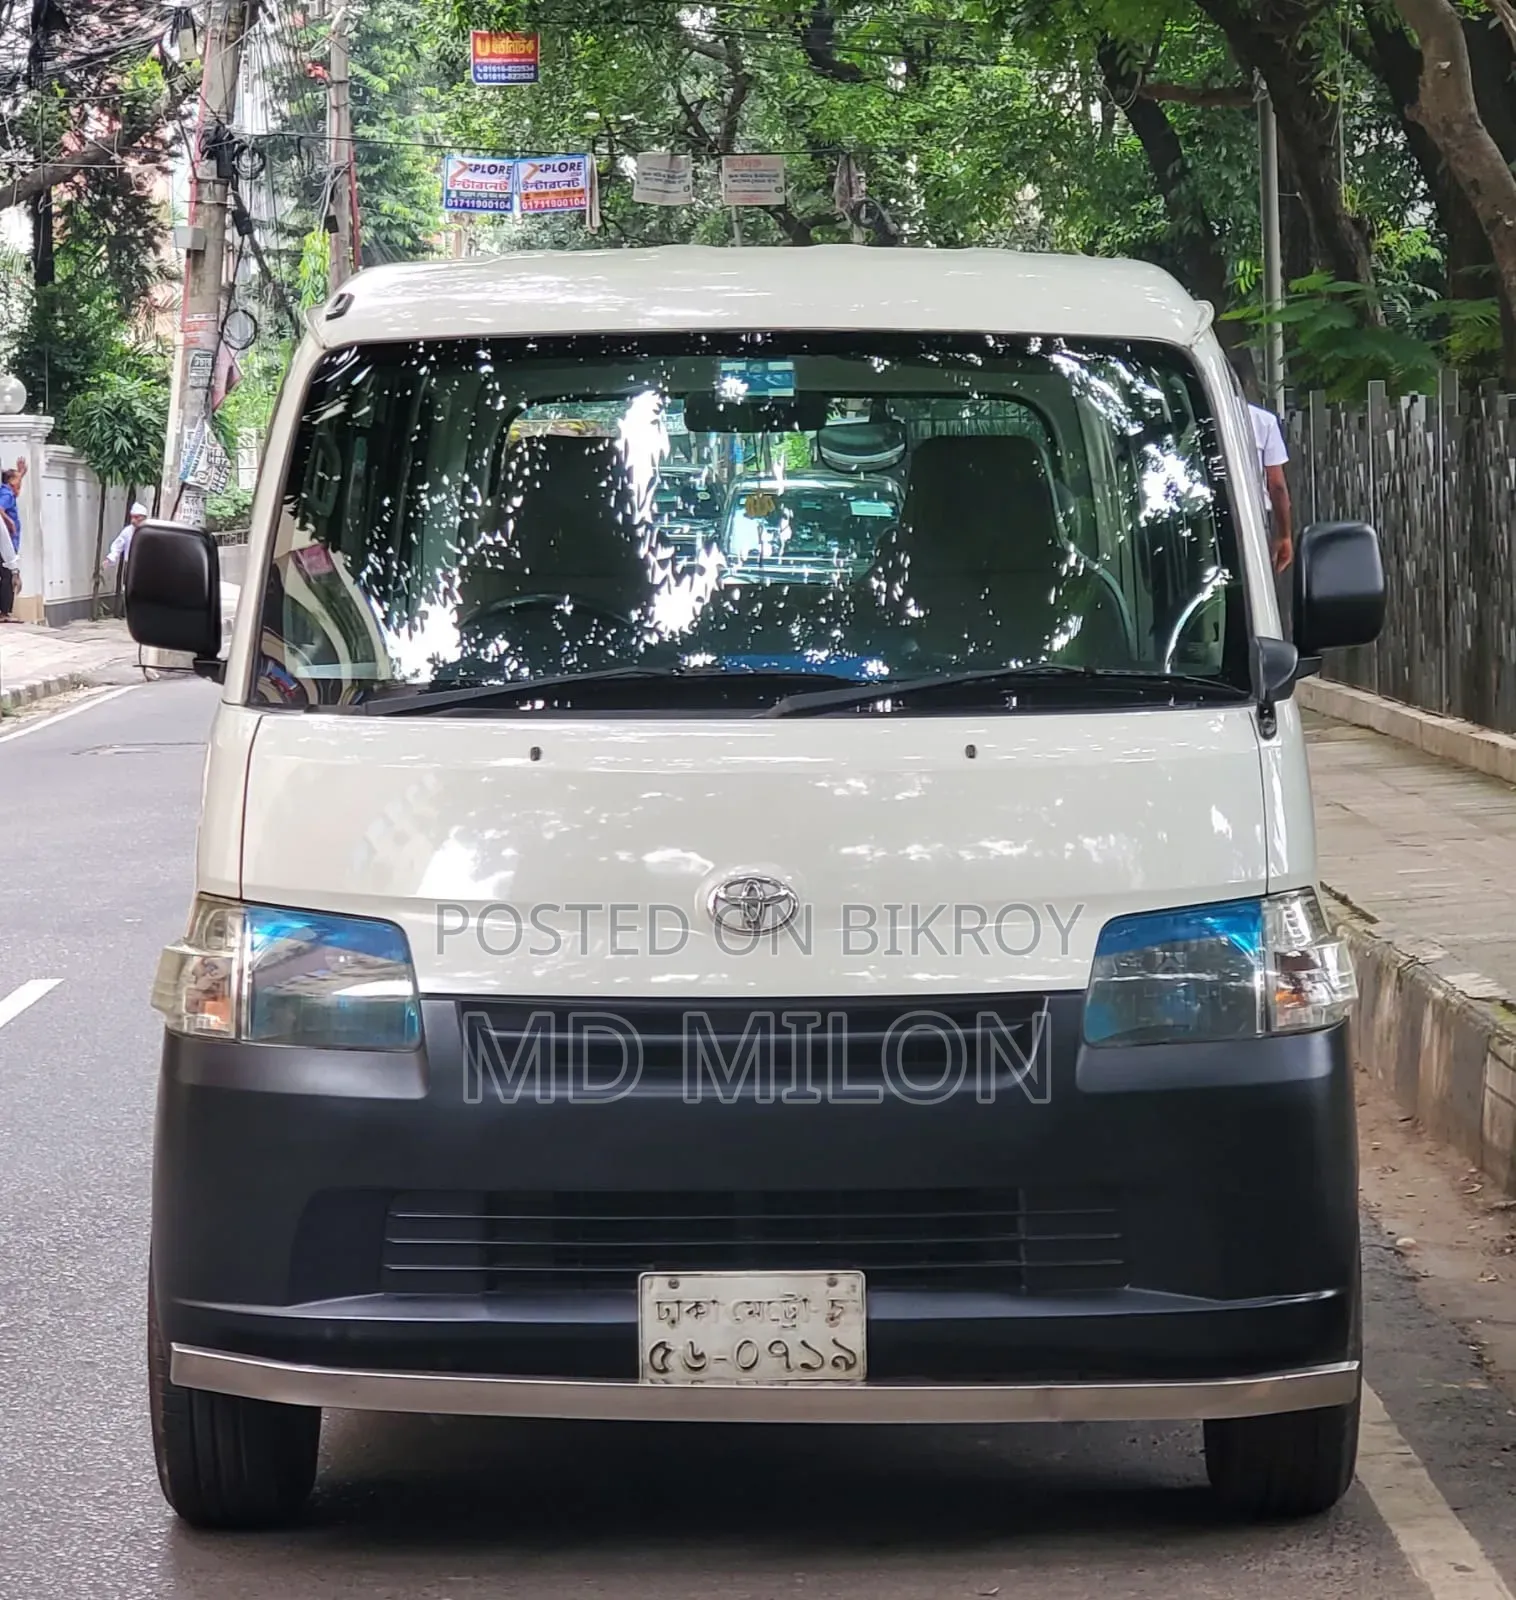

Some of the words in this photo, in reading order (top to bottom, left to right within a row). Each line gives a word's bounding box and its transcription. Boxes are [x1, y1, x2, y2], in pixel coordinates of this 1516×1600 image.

[523, 161, 583, 180] XPLORE
[449, 179, 508, 191] ইন্টারনেট
[522, 178, 580, 190] ইন্টারনেট
[655, 1297, 722, 1326] ঢাকা
[649, 1339, 859, 1374] ৫৬-০৭১৯
